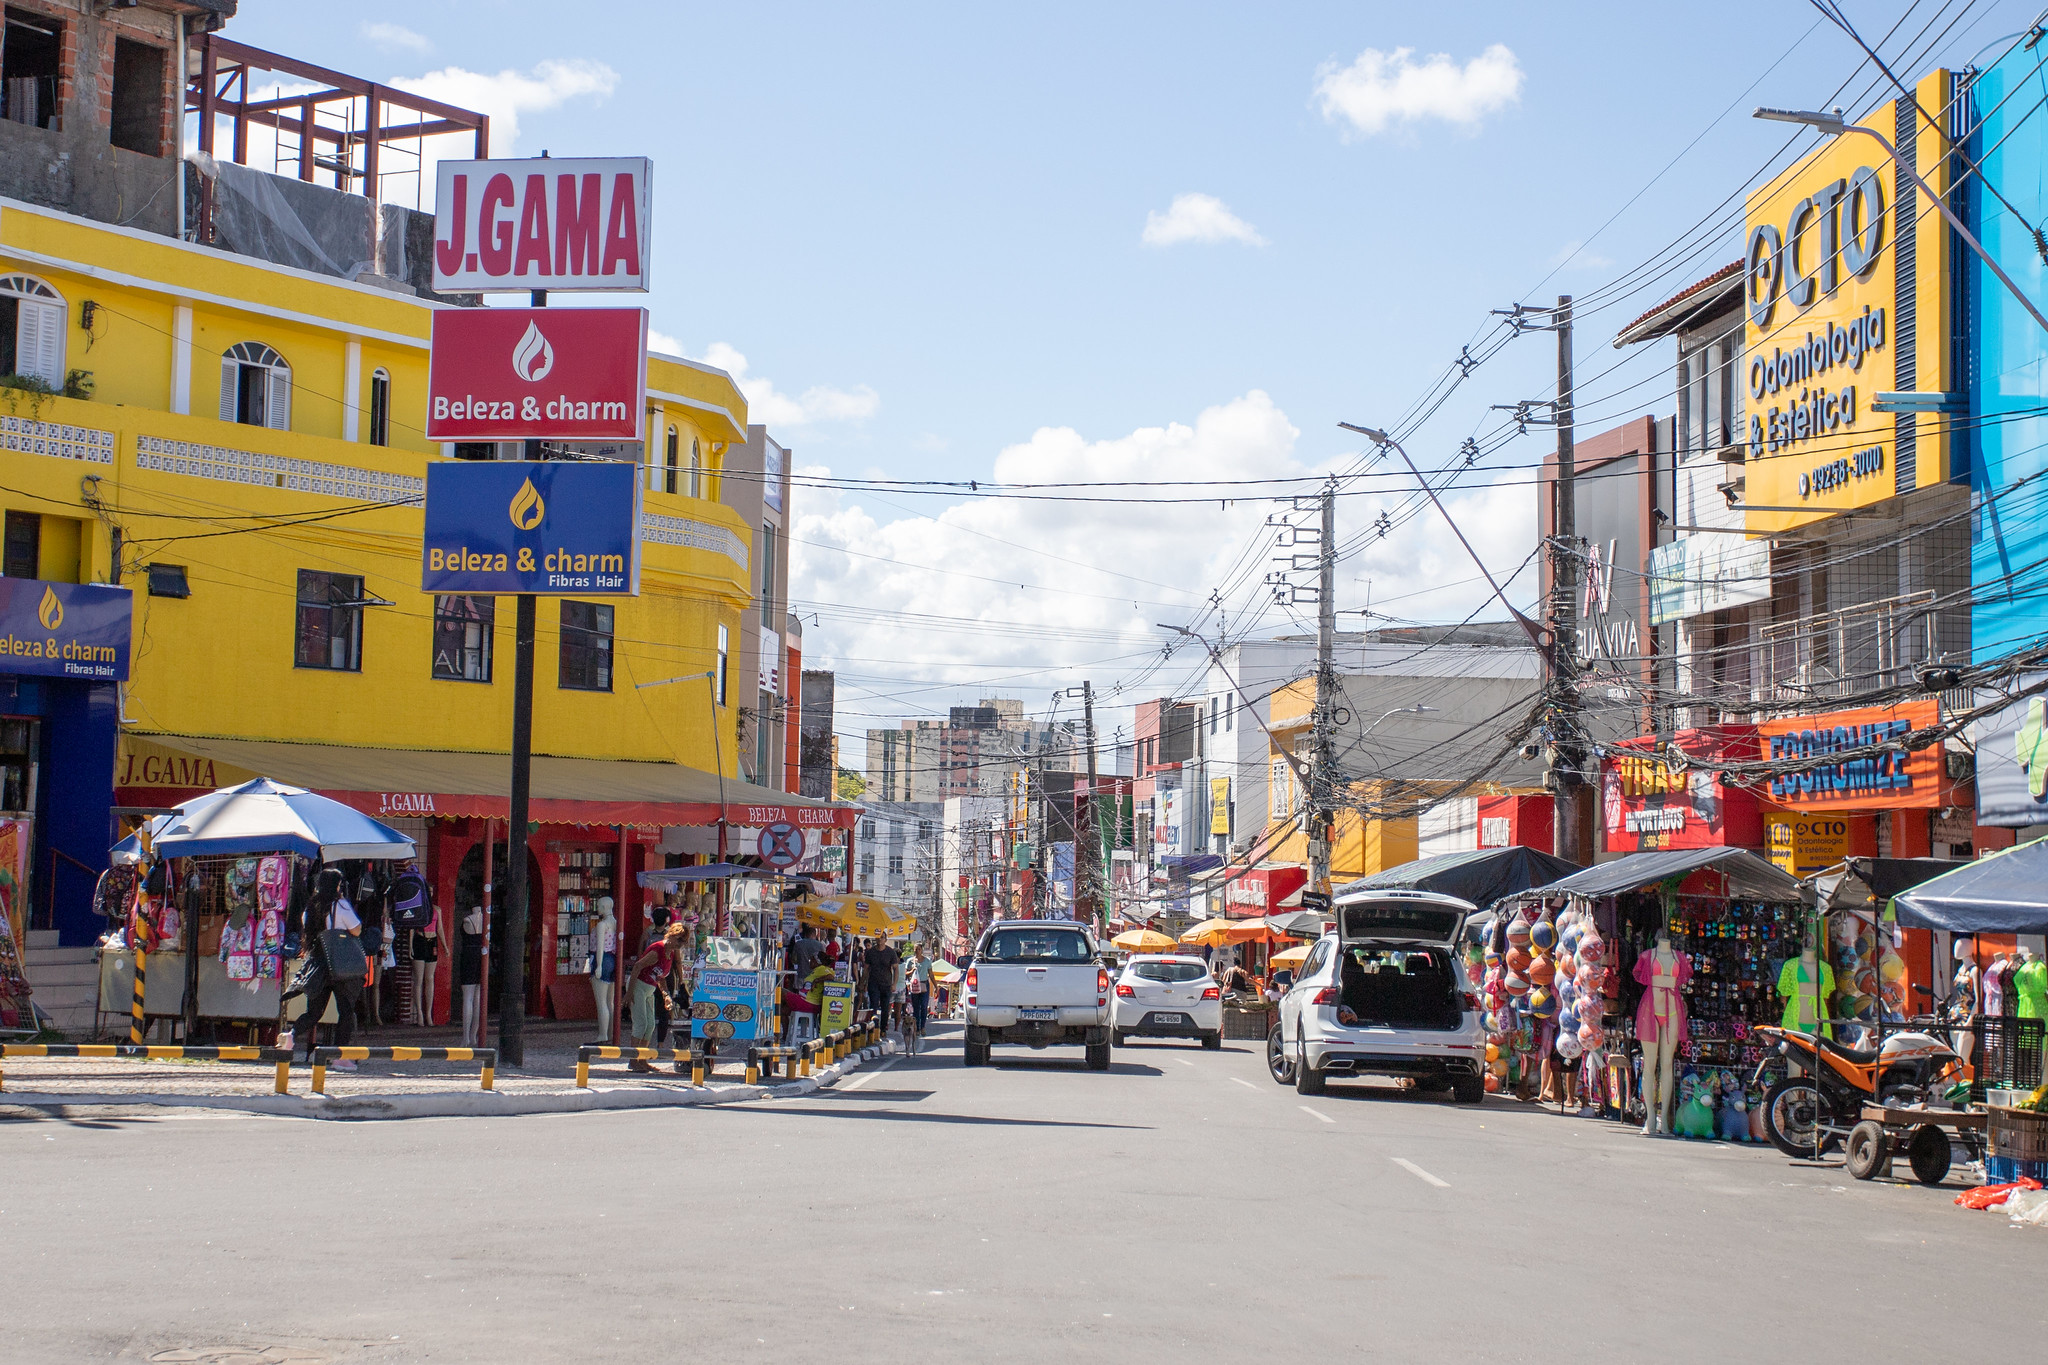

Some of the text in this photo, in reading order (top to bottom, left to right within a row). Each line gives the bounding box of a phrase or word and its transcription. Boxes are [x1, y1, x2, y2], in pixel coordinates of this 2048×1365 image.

[436, 173, 640, 277] J.GAMA
[1745, 165, 1885, 327] OCTO
[1751, 305, 1886, 400] Odontologia
[434, 395, 626, 421] Beleza & charm
[1748, 386, 1856, 458] & Estética
[1811, 445, 1883, 492] 99258-3000
[429, 547, 623, 573] Beleza & charm
[549, 574, 624, 588] Fibras Hair
[0, 633, 116, 663] eleza & charm
[1604, 618, 1640, 658] VIVA
[65, 662, 115, 677] Fibras Hair
[1770, 719, 1912, 795] ECONOMIZE
[120, 754, 218, 788] J.GAMA
[379, 793, 435, 813] J.GAMA
[748, 807, 834, 823] BELEZA CHARM
[1625, 806, 1685, 833] IMPORTADOS
[1795, 821, 1846, 835] OCTO
[1805, 846, 1833, 854] Estética
[728, 975, 736, 986] DE
